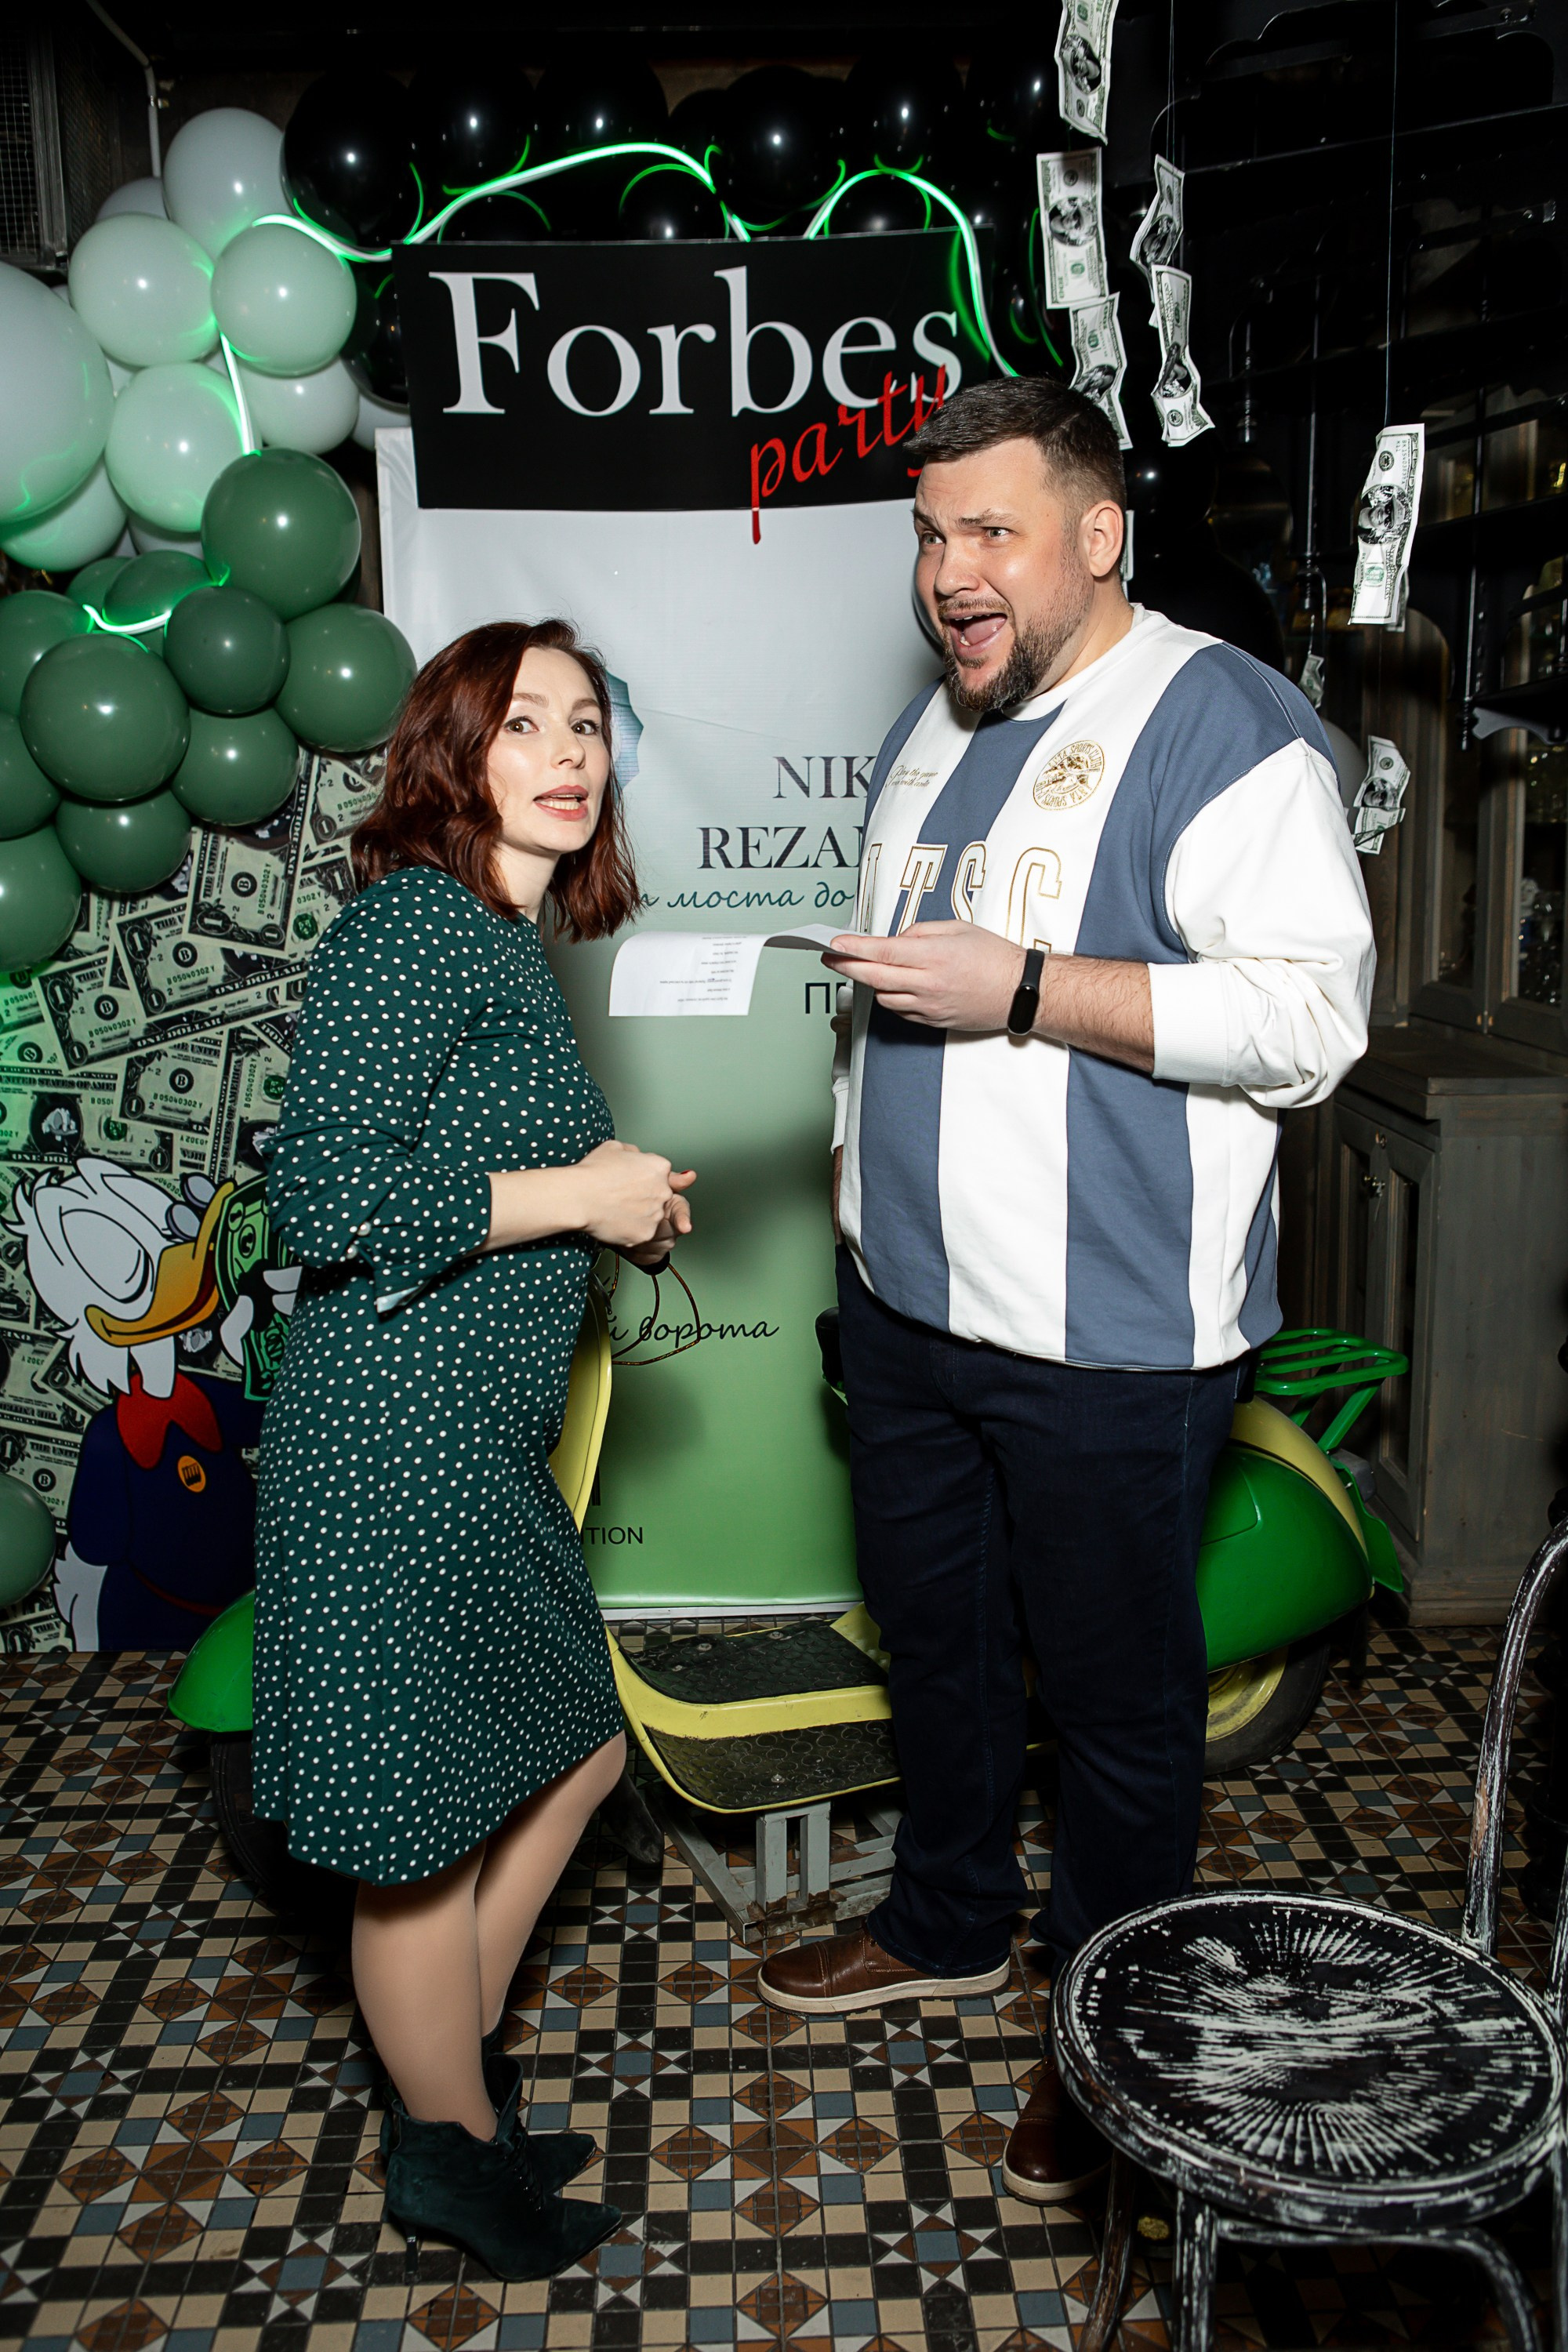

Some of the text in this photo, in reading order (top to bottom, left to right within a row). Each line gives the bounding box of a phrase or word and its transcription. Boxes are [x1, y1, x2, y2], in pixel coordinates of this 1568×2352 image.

[429, 265, 962, 417] Forbes
[750, 364, 946, 544] party
[667, 888, 804, 909] моста
[814, 881, 856, 909] до
[638, 1315, 780, 1349] ворота
